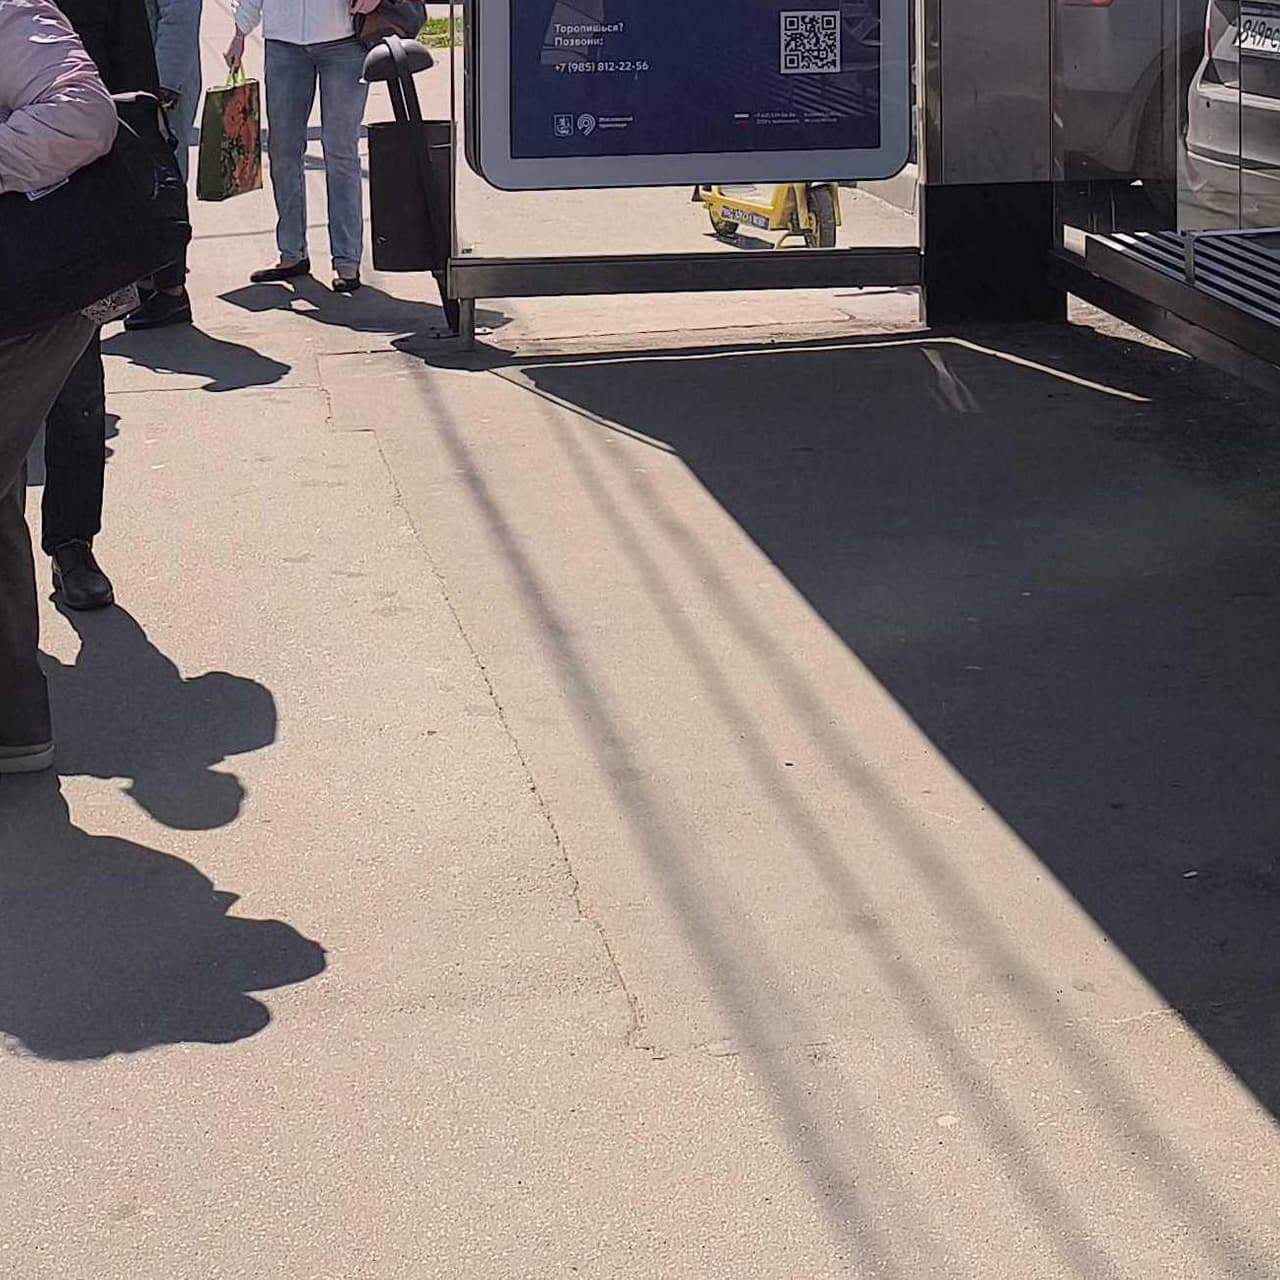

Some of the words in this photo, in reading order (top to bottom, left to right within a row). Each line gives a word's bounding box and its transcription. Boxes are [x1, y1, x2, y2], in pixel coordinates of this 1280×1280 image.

[554, 22, 624, 35] Торопишься?
[554, 36, 604, 47] Позвони:
[555, 62, 566, 73] +7
[568, 61, 595, 74] (985)
[597, 61, 649, 72] 812-22-56
